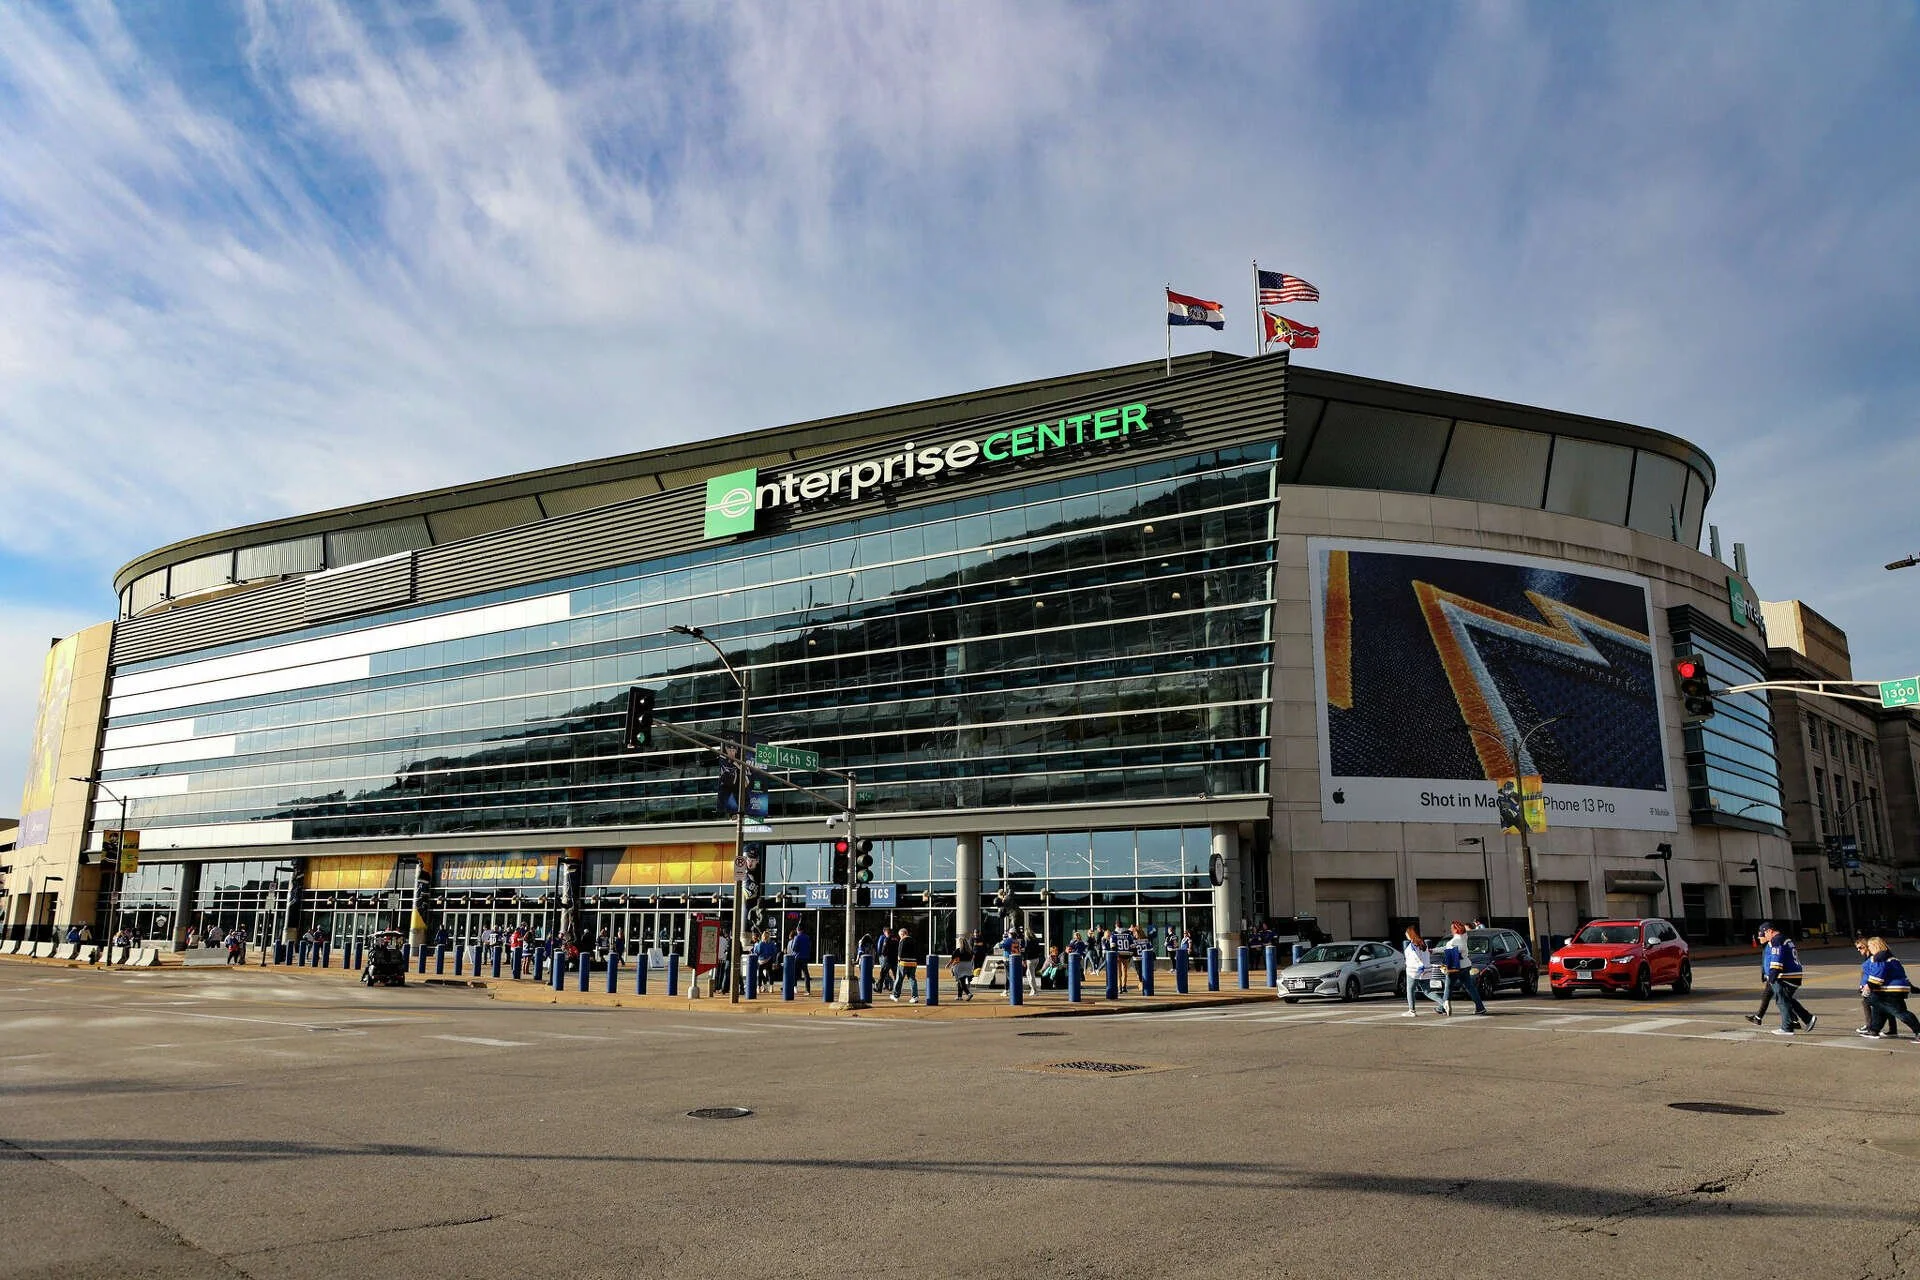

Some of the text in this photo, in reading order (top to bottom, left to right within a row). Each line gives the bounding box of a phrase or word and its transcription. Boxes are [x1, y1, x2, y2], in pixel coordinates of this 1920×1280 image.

[983, 402, 1148, 461] CENTER
[1885, 686, 1915, 699] 1300
[780, 751, 817, 768] 14th St
[1420, 791, 1456, 807] Shot
[1458, 792, 1471, 808] in
[1582, 798, 1595, 812] 13
[1597, 799, 1616, 814] Pro
[456, 860, 486, 880] LOUIS
[483, 858, 538, 880] BLUES
[811, 889, 829, 900] STL
[1117, 939, 1130, 951] 90
